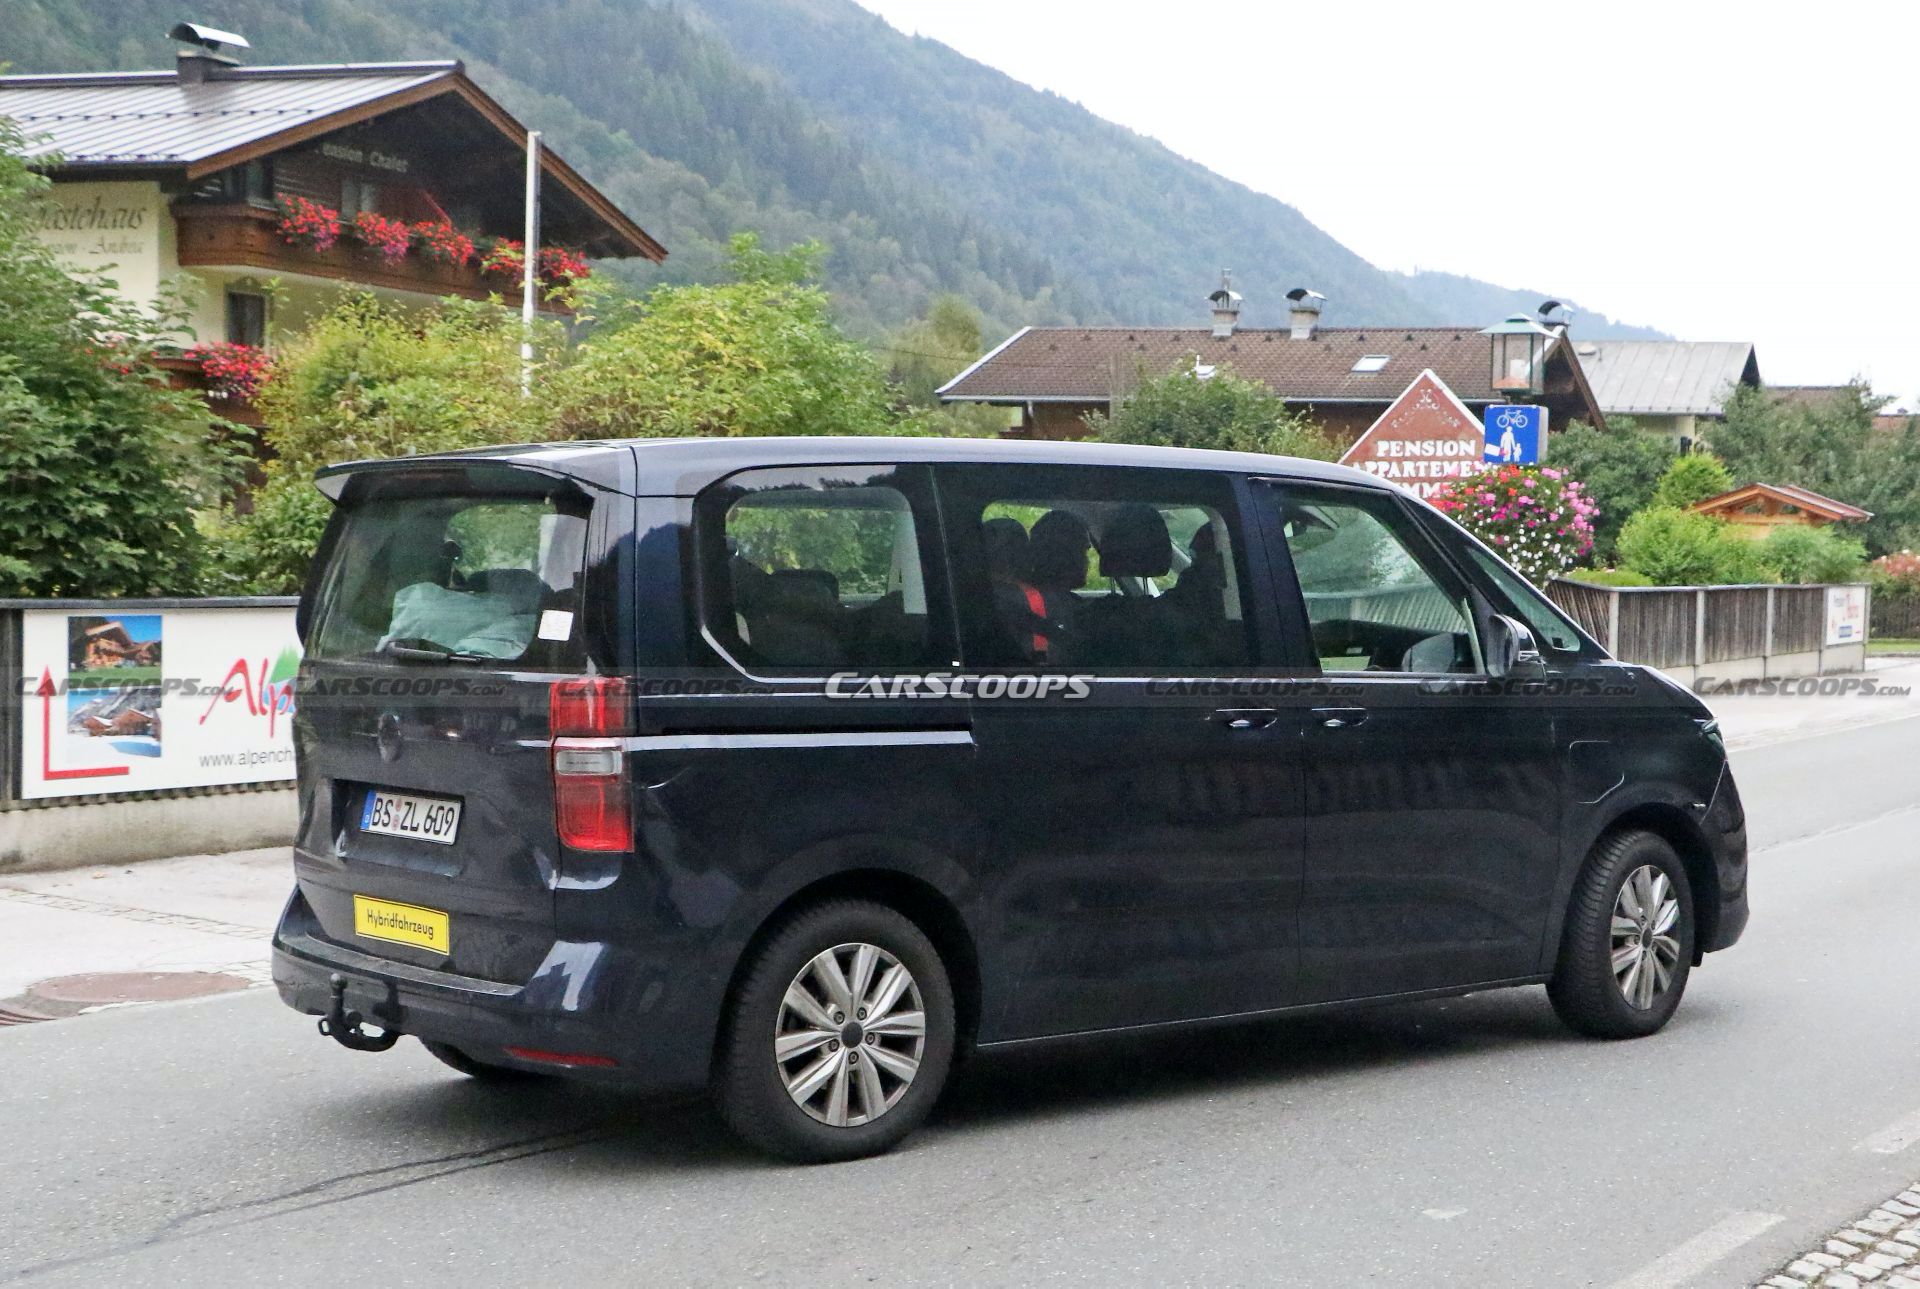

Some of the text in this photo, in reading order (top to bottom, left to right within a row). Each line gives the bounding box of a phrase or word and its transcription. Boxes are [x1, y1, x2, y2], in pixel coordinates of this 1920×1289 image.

[1376, 440, 1476, 457] PENSION
[199, 657, 297, 738] Alp
[199, 746, 296, 767] www.alpench
[371, 797, 394, 828] BS
[400, 801, 420, 832] ZL
[423, 804, 456, 837] 609
[366, 908, 434, 941] Hybridfahrzeug
